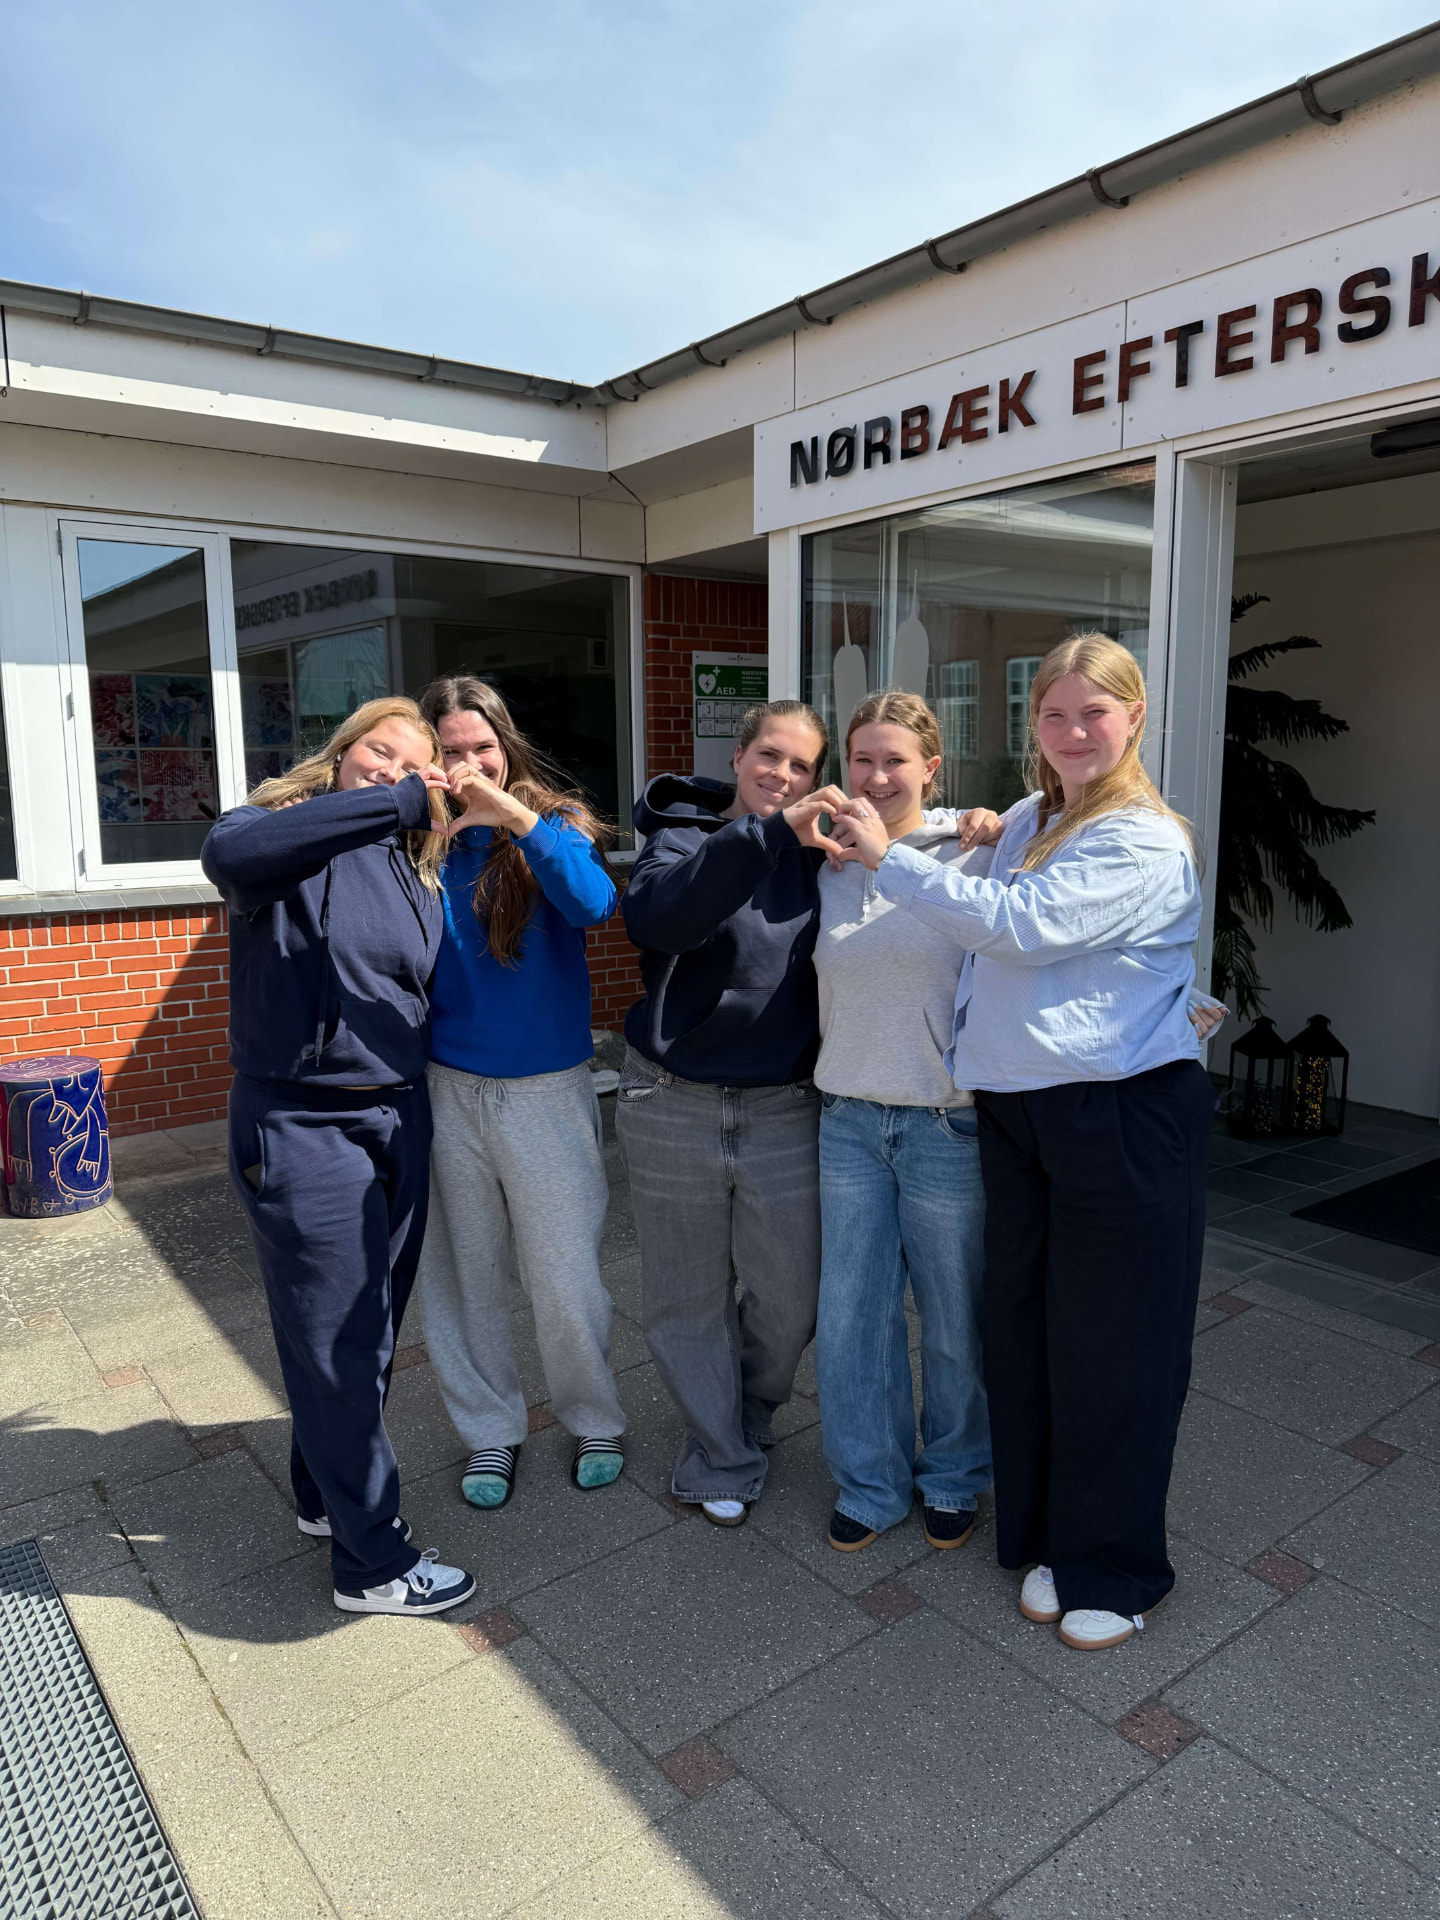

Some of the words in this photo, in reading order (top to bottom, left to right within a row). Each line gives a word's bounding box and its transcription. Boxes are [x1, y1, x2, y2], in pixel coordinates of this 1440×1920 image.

[789, 370, 1036, 488] NØRBÆK
[1072, 252, 1440, 415] EFTERSK
[716, 687, 736, 695] AED
